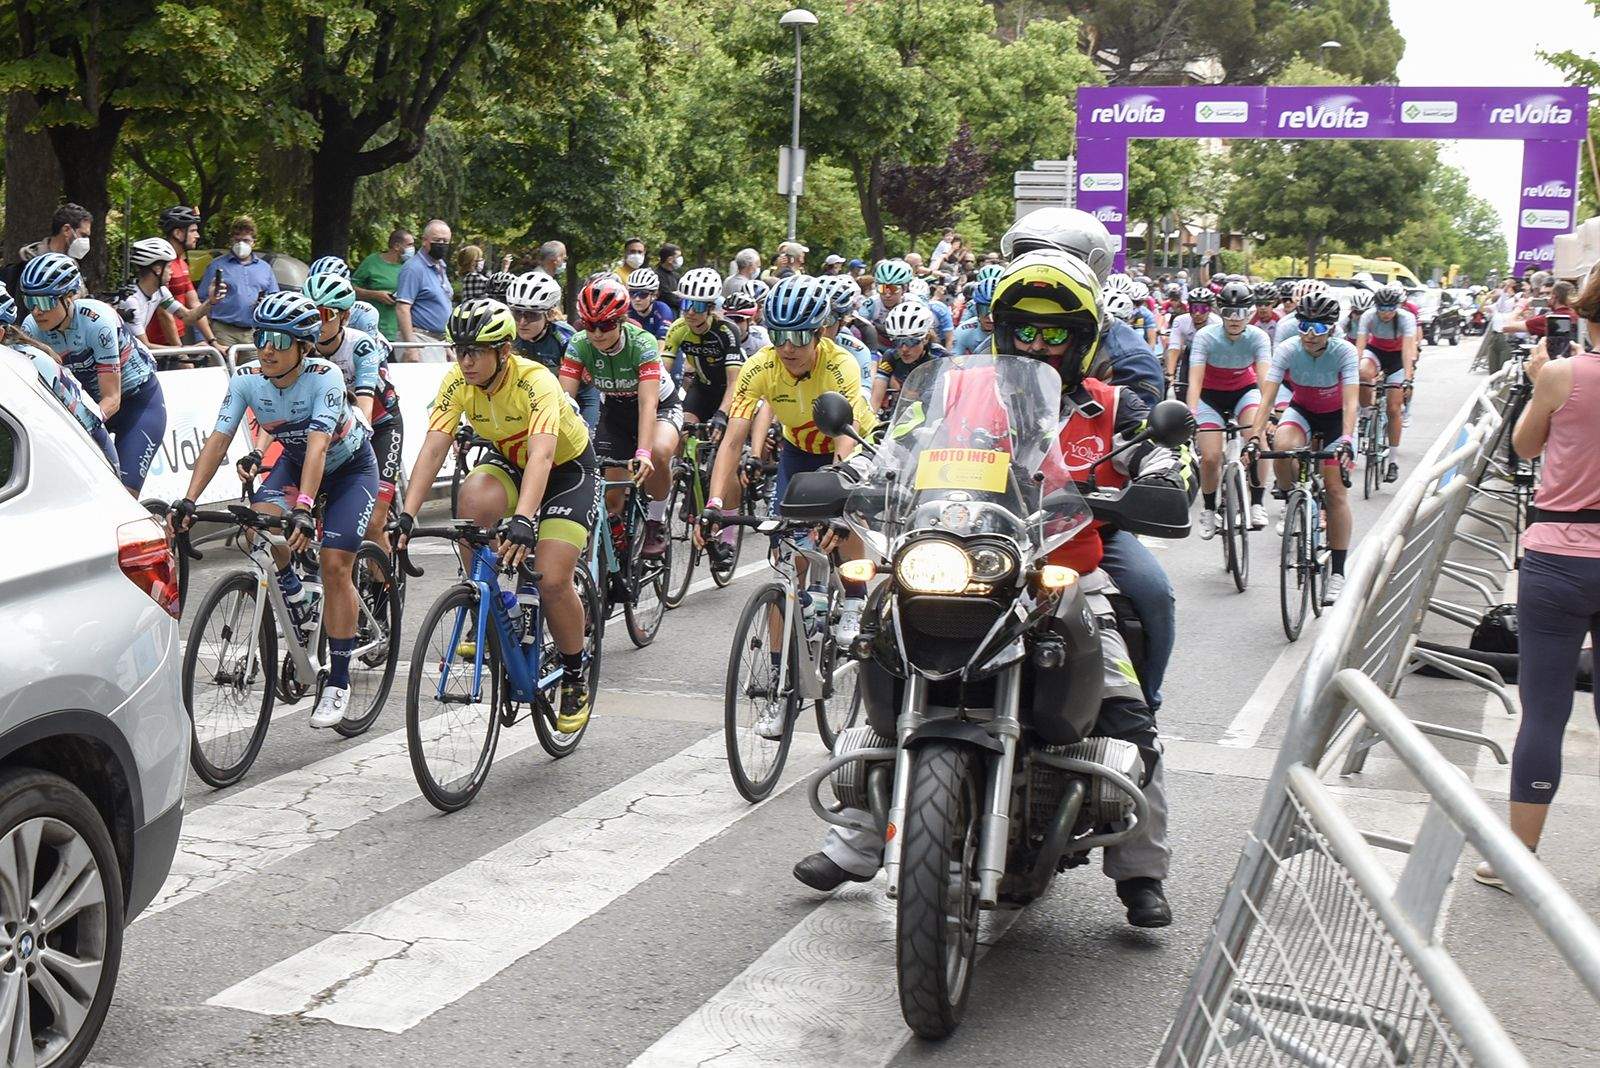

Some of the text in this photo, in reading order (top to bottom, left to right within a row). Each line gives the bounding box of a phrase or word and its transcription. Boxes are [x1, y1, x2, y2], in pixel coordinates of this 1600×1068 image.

[1091, 103, 1166, 123] reVolta
[1278, 105, 1370, 128] reVolta
[1489, 103, 1573, 124] reVolta
[1522, 184, 1572, 198] reVolta
[1517, 247, 1554, 261] reVol
[929, 449, 997, 464] MOTO INFO
[546, 505, 574, 516] BH
